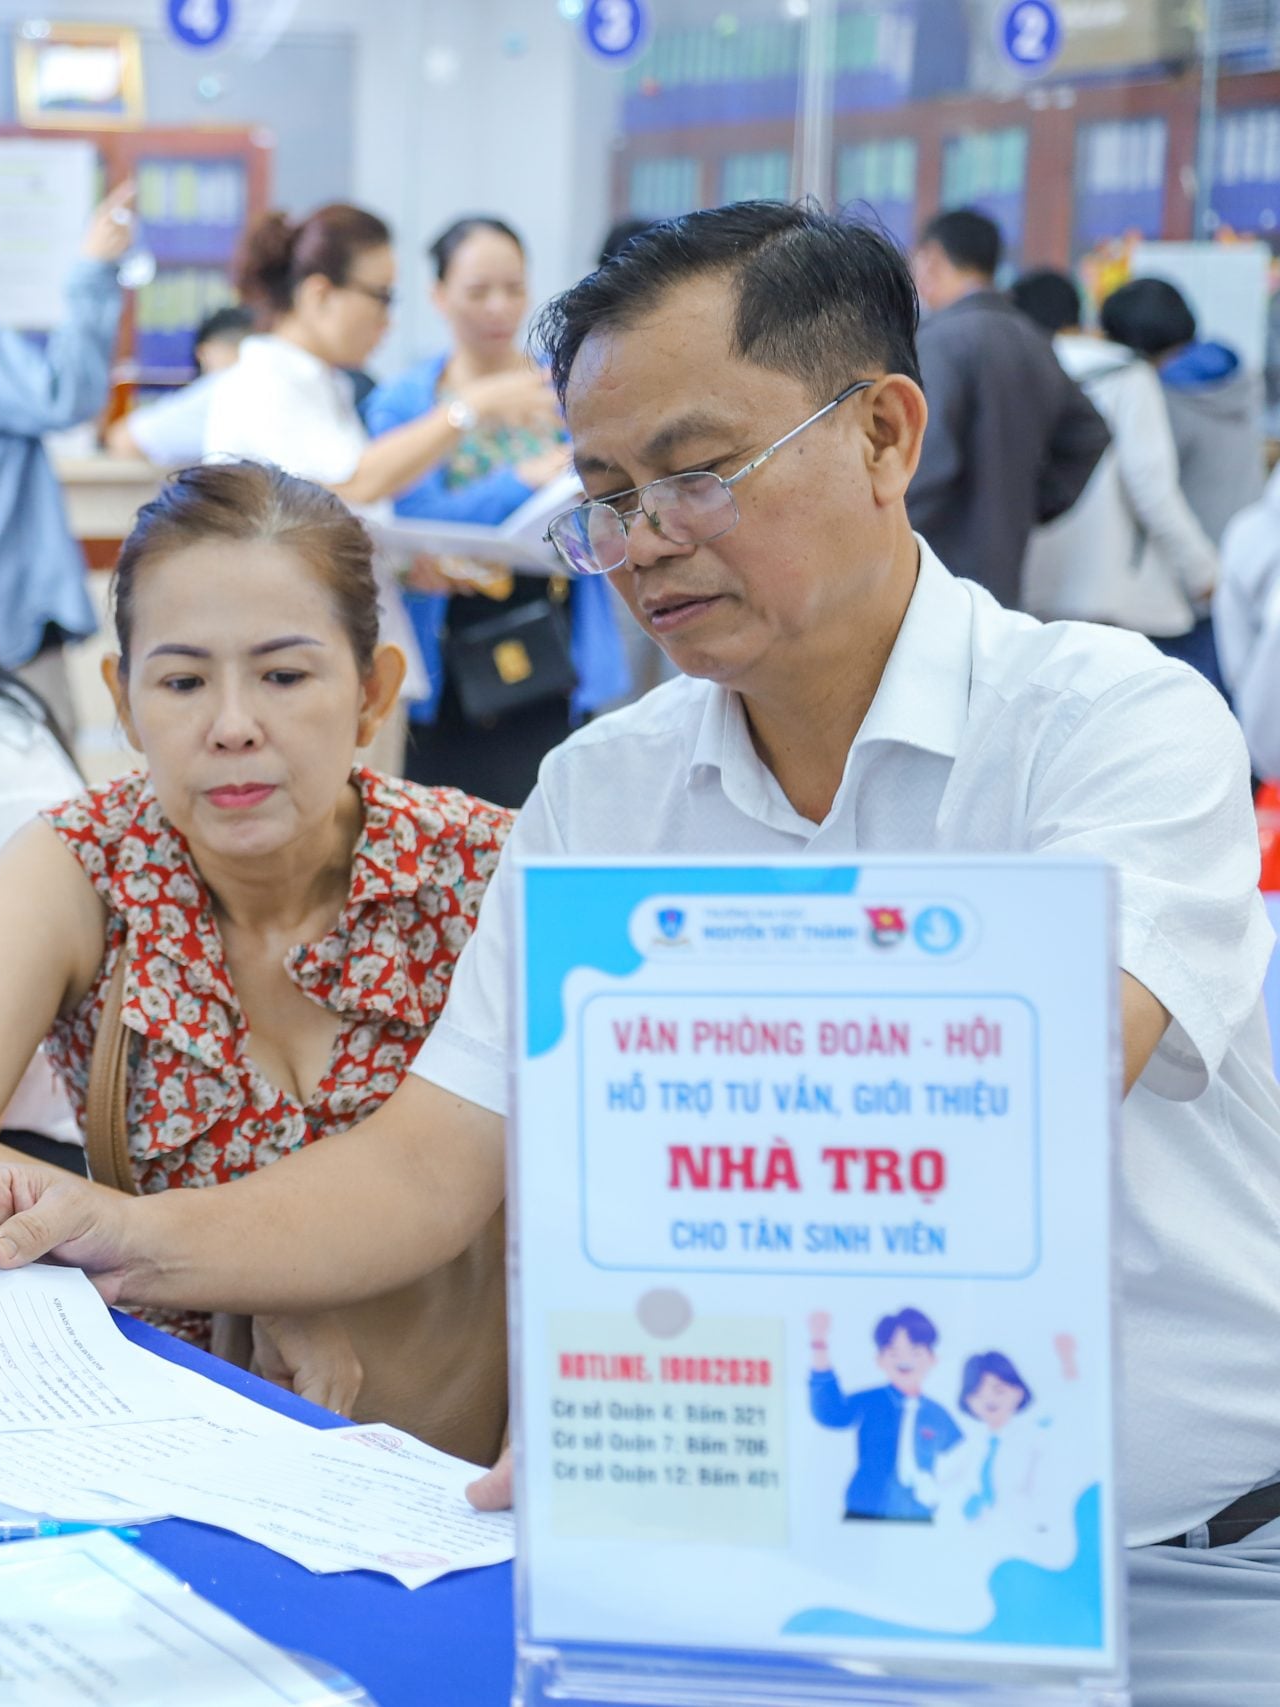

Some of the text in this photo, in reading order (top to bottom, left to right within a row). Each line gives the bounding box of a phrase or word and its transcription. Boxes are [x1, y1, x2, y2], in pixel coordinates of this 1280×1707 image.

[179, 0, 219, 39] 4
[594, 0, 631, 50] 3
[1013, 3, 1049, 59] 2
[612, 1015, 678, 1056] VĂN
[692, 1013, 805, 1056] PHÒNG
[818, 1015, 910, 1057] ĐOÀN
[945, 1014, 1003, 1064] HỘI
[607, 1071, 646, 1113] HỖ
[852, 1079, 912, 1116] GIỚI
[924, 1077, 1010, 1121] THIỆU
[668, 1136, 947, 1206] NHÀ TRỌ
[670, 1215, 948, 1256] CHO TÂN SINH VIÊN
